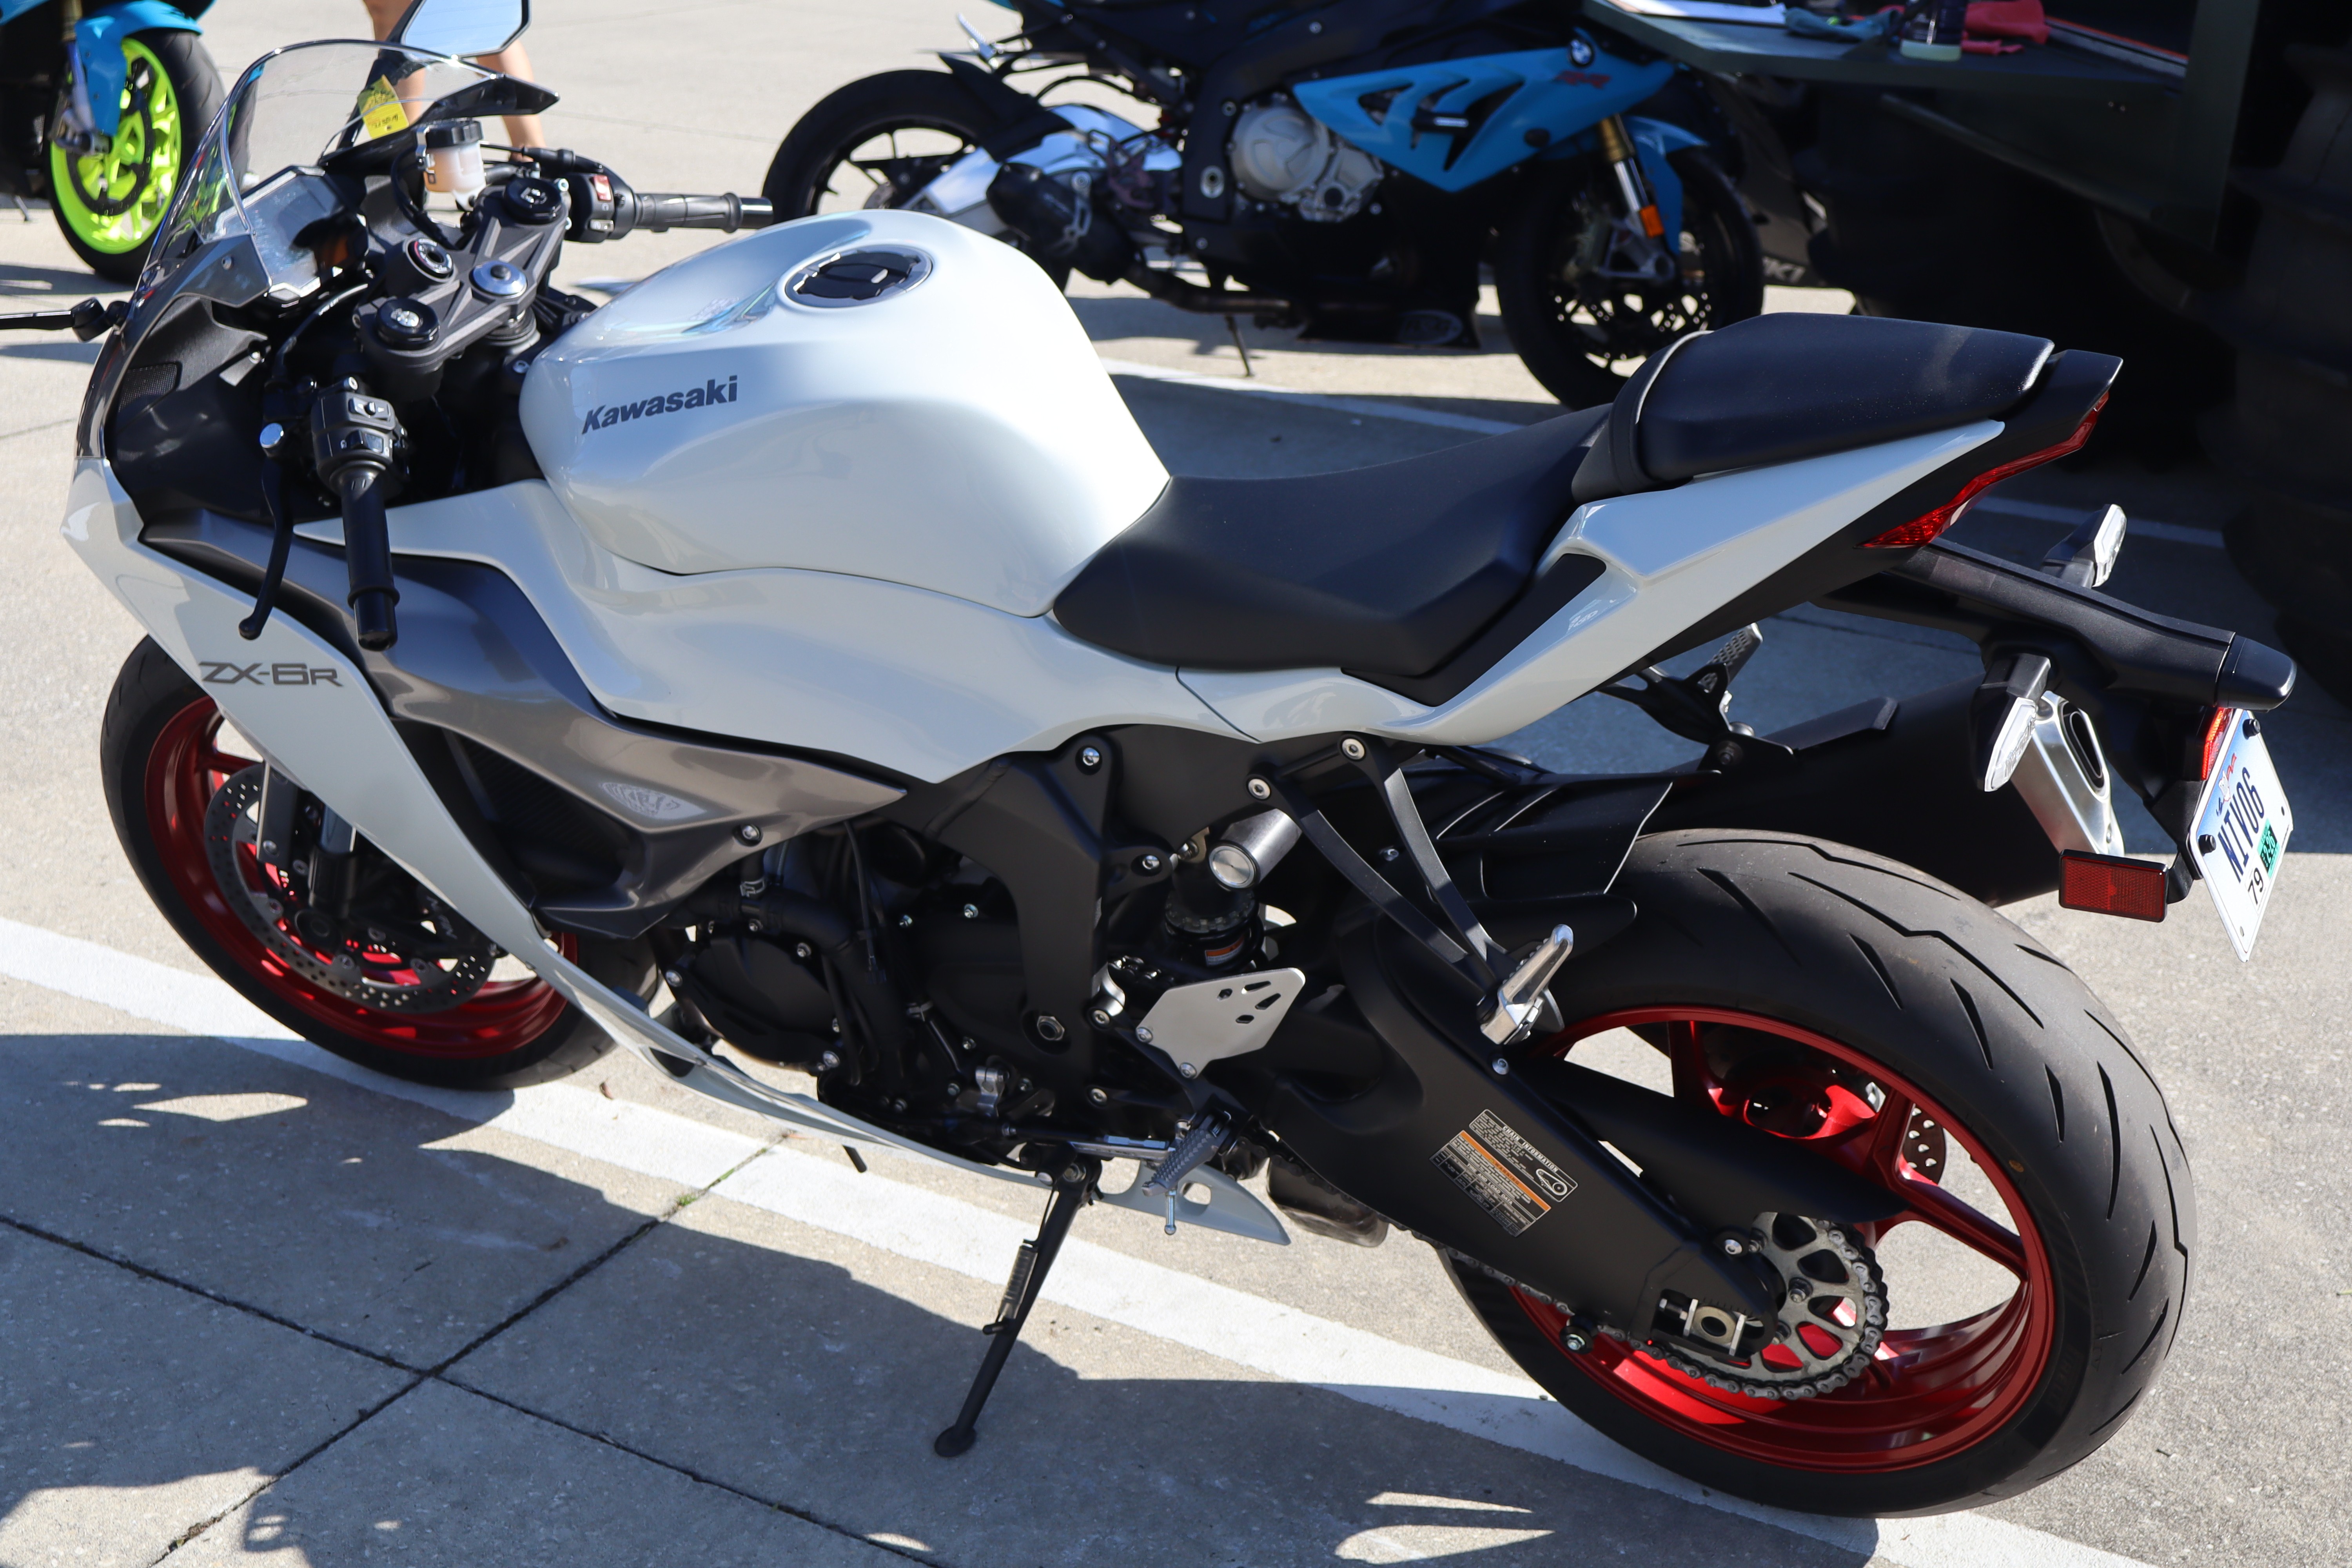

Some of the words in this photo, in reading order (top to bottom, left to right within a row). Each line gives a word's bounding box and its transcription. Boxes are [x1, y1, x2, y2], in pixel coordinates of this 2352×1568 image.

[582, 375, 737, 434] Kawasaki
[199, 661, 343, 686] ZX-6R
[2218, 767, 2264, 884] NIV06
[2247, 867, 2264, 905] 79
[1503, 1125, 1521, 1141] CHAIN
[1521, 1142, 1559, 1172] INFORMATION
[1467, 1163, 1477, 1172] TIRE
[1477, 1173, 1488, 1182] AND
[1488, 1182, 1501, 1194] LOAD
[1501, 1194, 1513, 1205] DATA
[1495, 1163, 1519, 1185] WARNING
